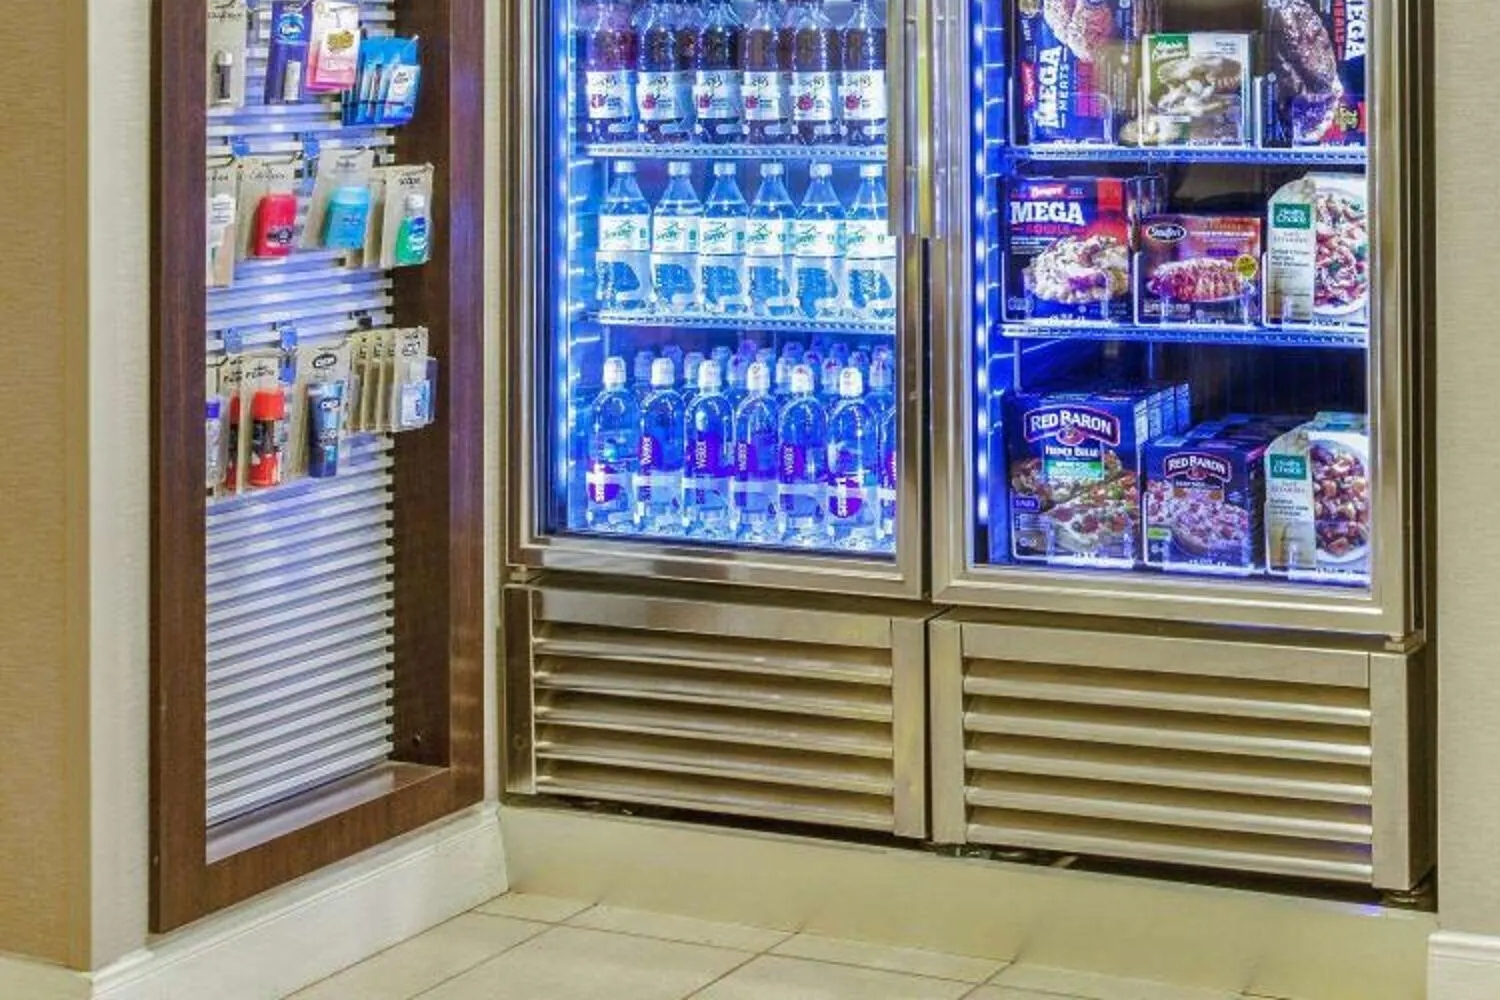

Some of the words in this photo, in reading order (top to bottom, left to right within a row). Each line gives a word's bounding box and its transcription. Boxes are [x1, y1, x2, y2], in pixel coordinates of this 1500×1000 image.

[1010, 201, 1086, 226] MEGA
[1031, 414, 1059, 432] RED
[1060, 409, 1112, 435] BARON
[1169, 456, 1189, 470] RED
[1190, 456, 1226, 474] BARON
